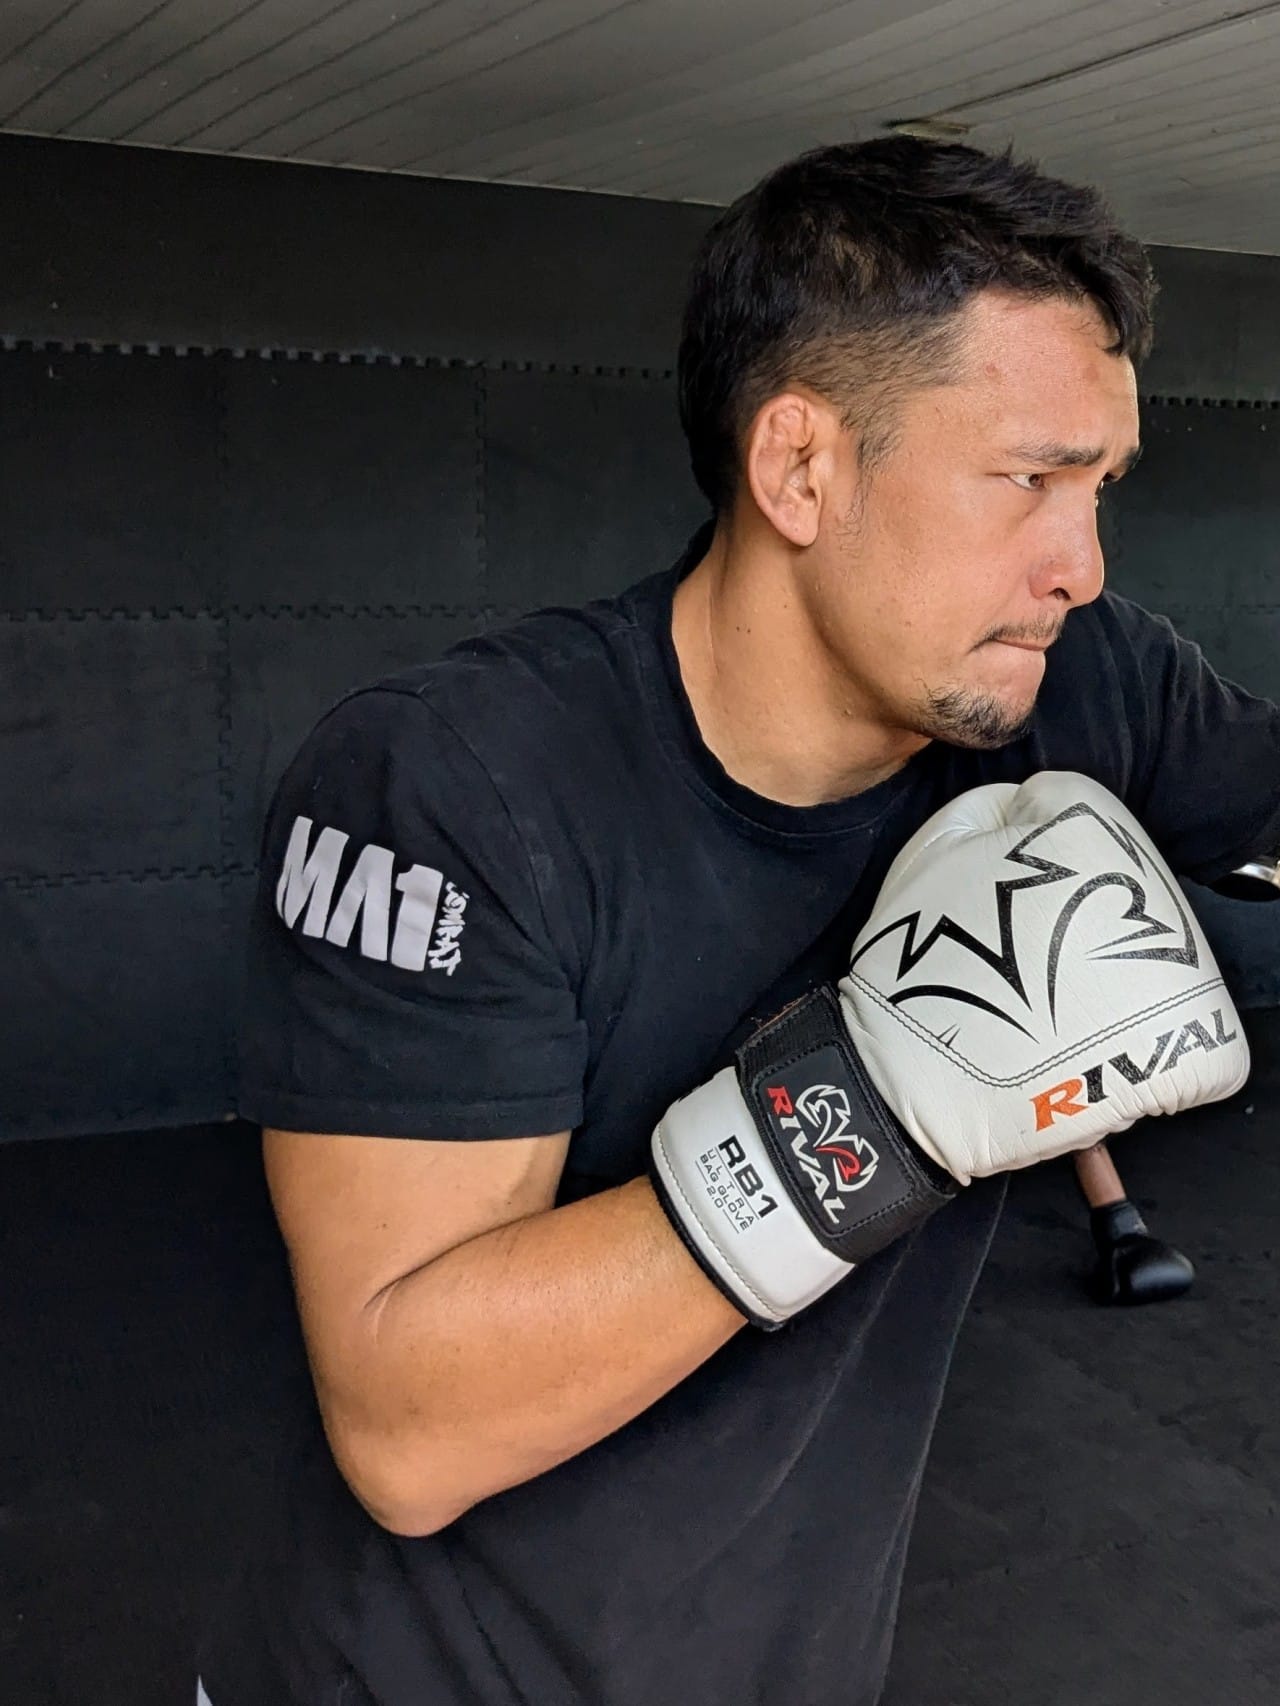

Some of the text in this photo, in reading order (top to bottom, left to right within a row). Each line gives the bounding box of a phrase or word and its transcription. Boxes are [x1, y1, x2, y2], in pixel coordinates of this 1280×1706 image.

[1029, 1008, 1238, 1132] RIVAL
[700, 1153, 750, 1230] BAG GLOVE
[707, 1148, 755, 1225] ULTRA
[718, 1134, 779, 1219] RB1
[767, 1086, 846, 1225] RIVAL
[706, 1186, 724, 1209] 2.0
